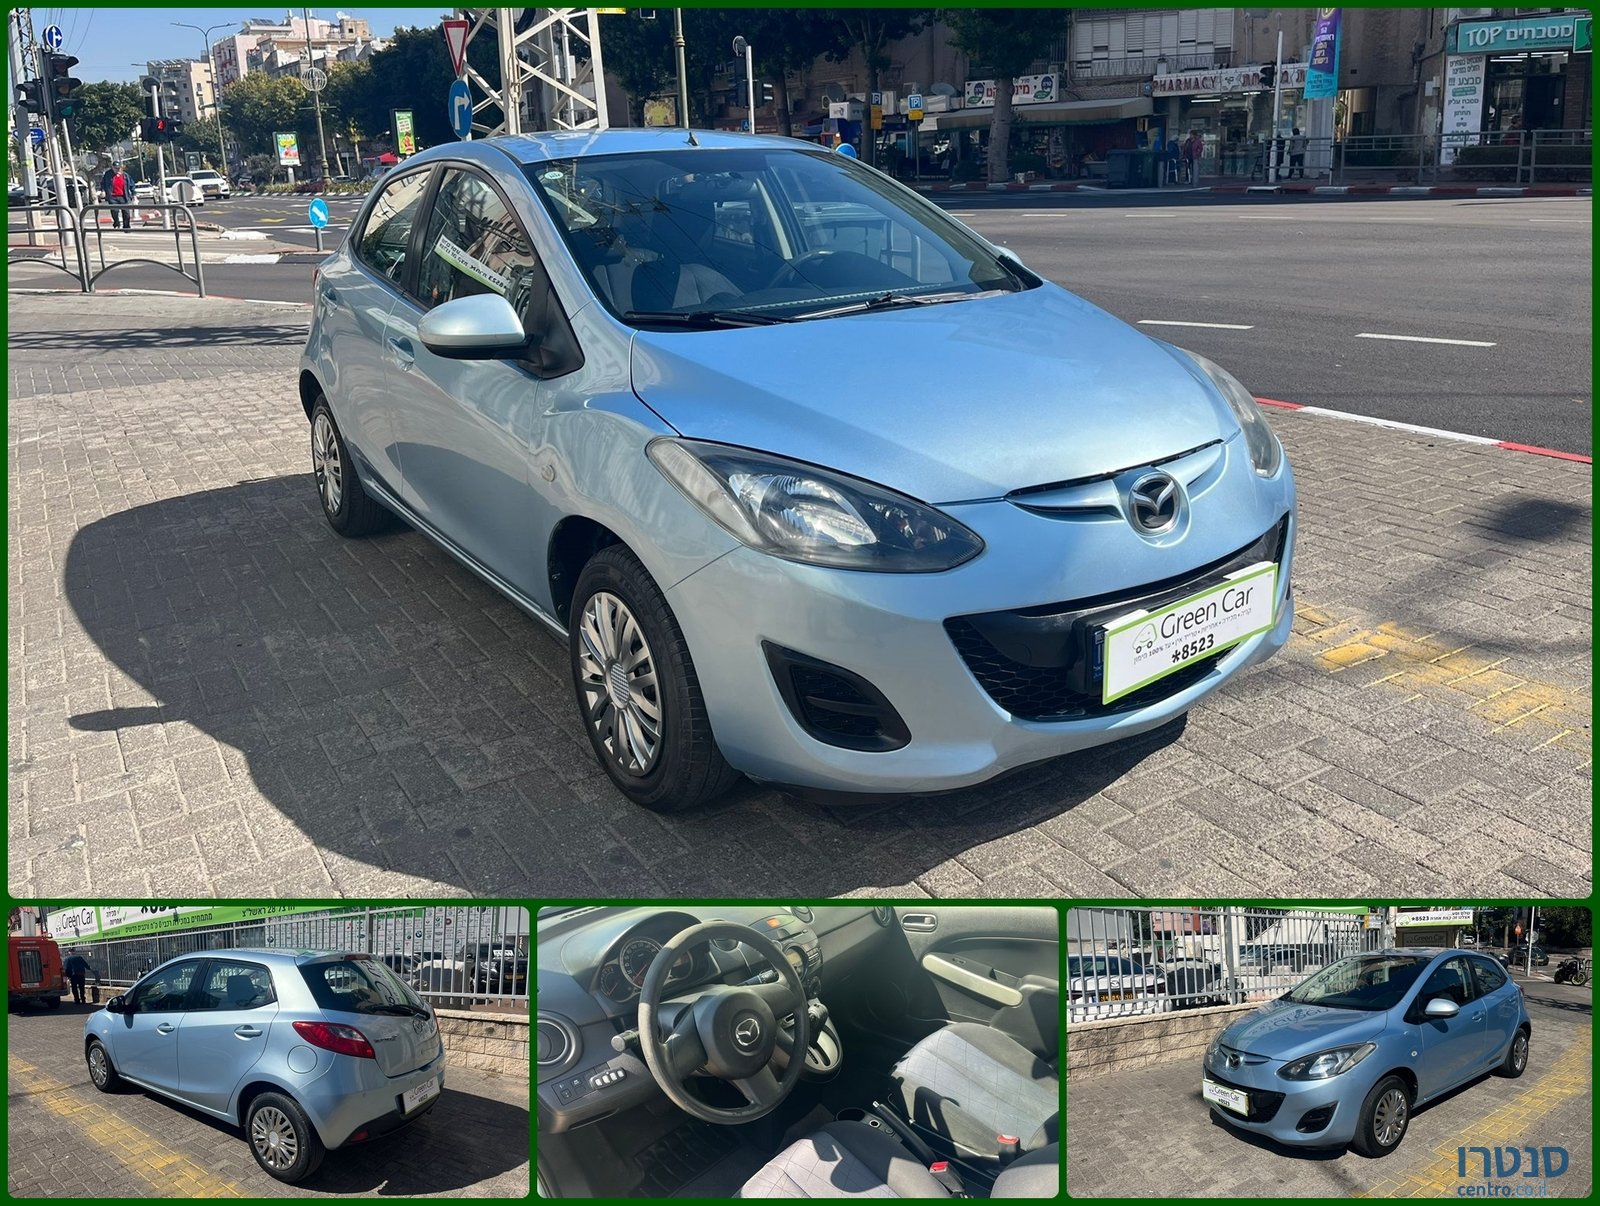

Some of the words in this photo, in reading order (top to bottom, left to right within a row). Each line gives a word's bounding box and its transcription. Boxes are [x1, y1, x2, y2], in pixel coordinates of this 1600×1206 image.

[1465, 26, 1503, 47] TOP
[1152, 75, 1217, 92] PHARMACY
[1161, 602, 1217, 639] Green
[1222, 586, 1254, 611] Car
[1148, 645, 1164, 657] 100%
[61, 913, 80, 930] Green
[81, 908, 94, 925] Car
[267, 906, 276, 914] 28
